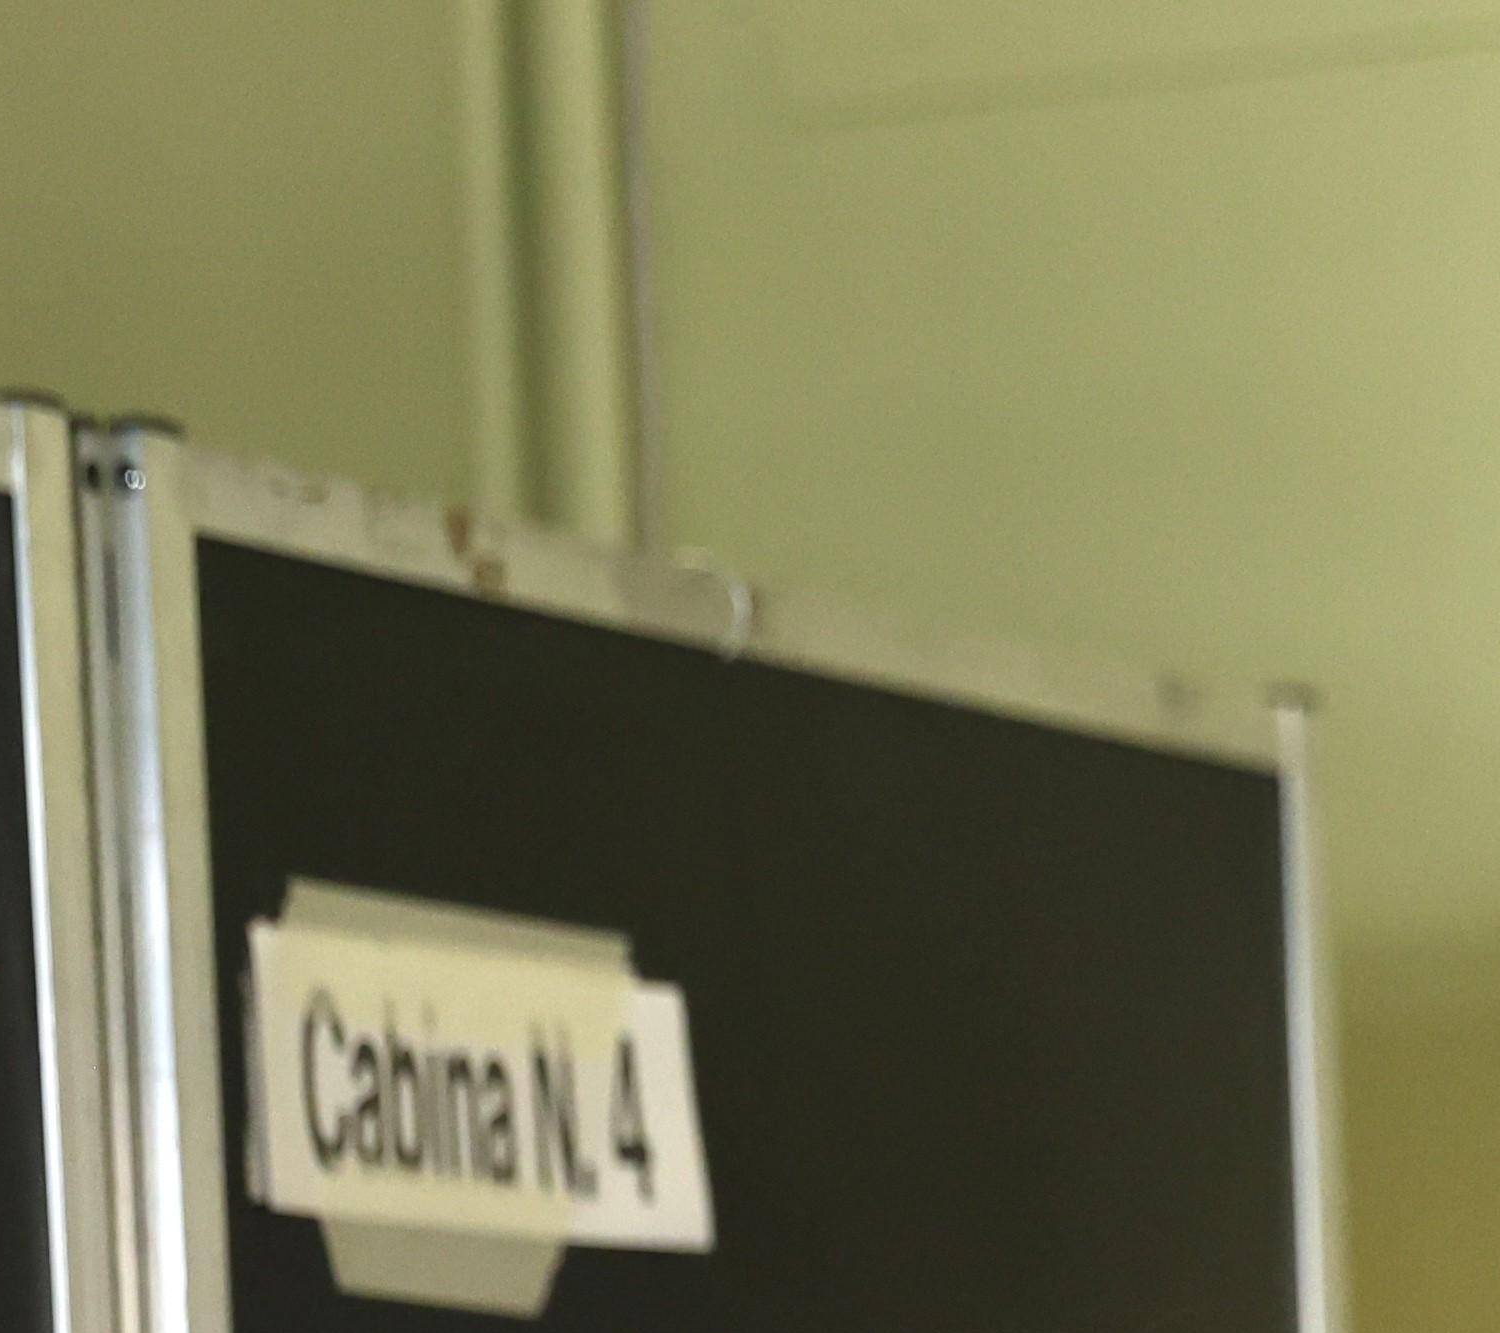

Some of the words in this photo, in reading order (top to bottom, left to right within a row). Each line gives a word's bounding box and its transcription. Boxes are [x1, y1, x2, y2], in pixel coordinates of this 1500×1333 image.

[303, 987, 515, 1185] Cabina
[528, 1014, 600, 1200] N.
[608, 1035, 653, 1205] 4
